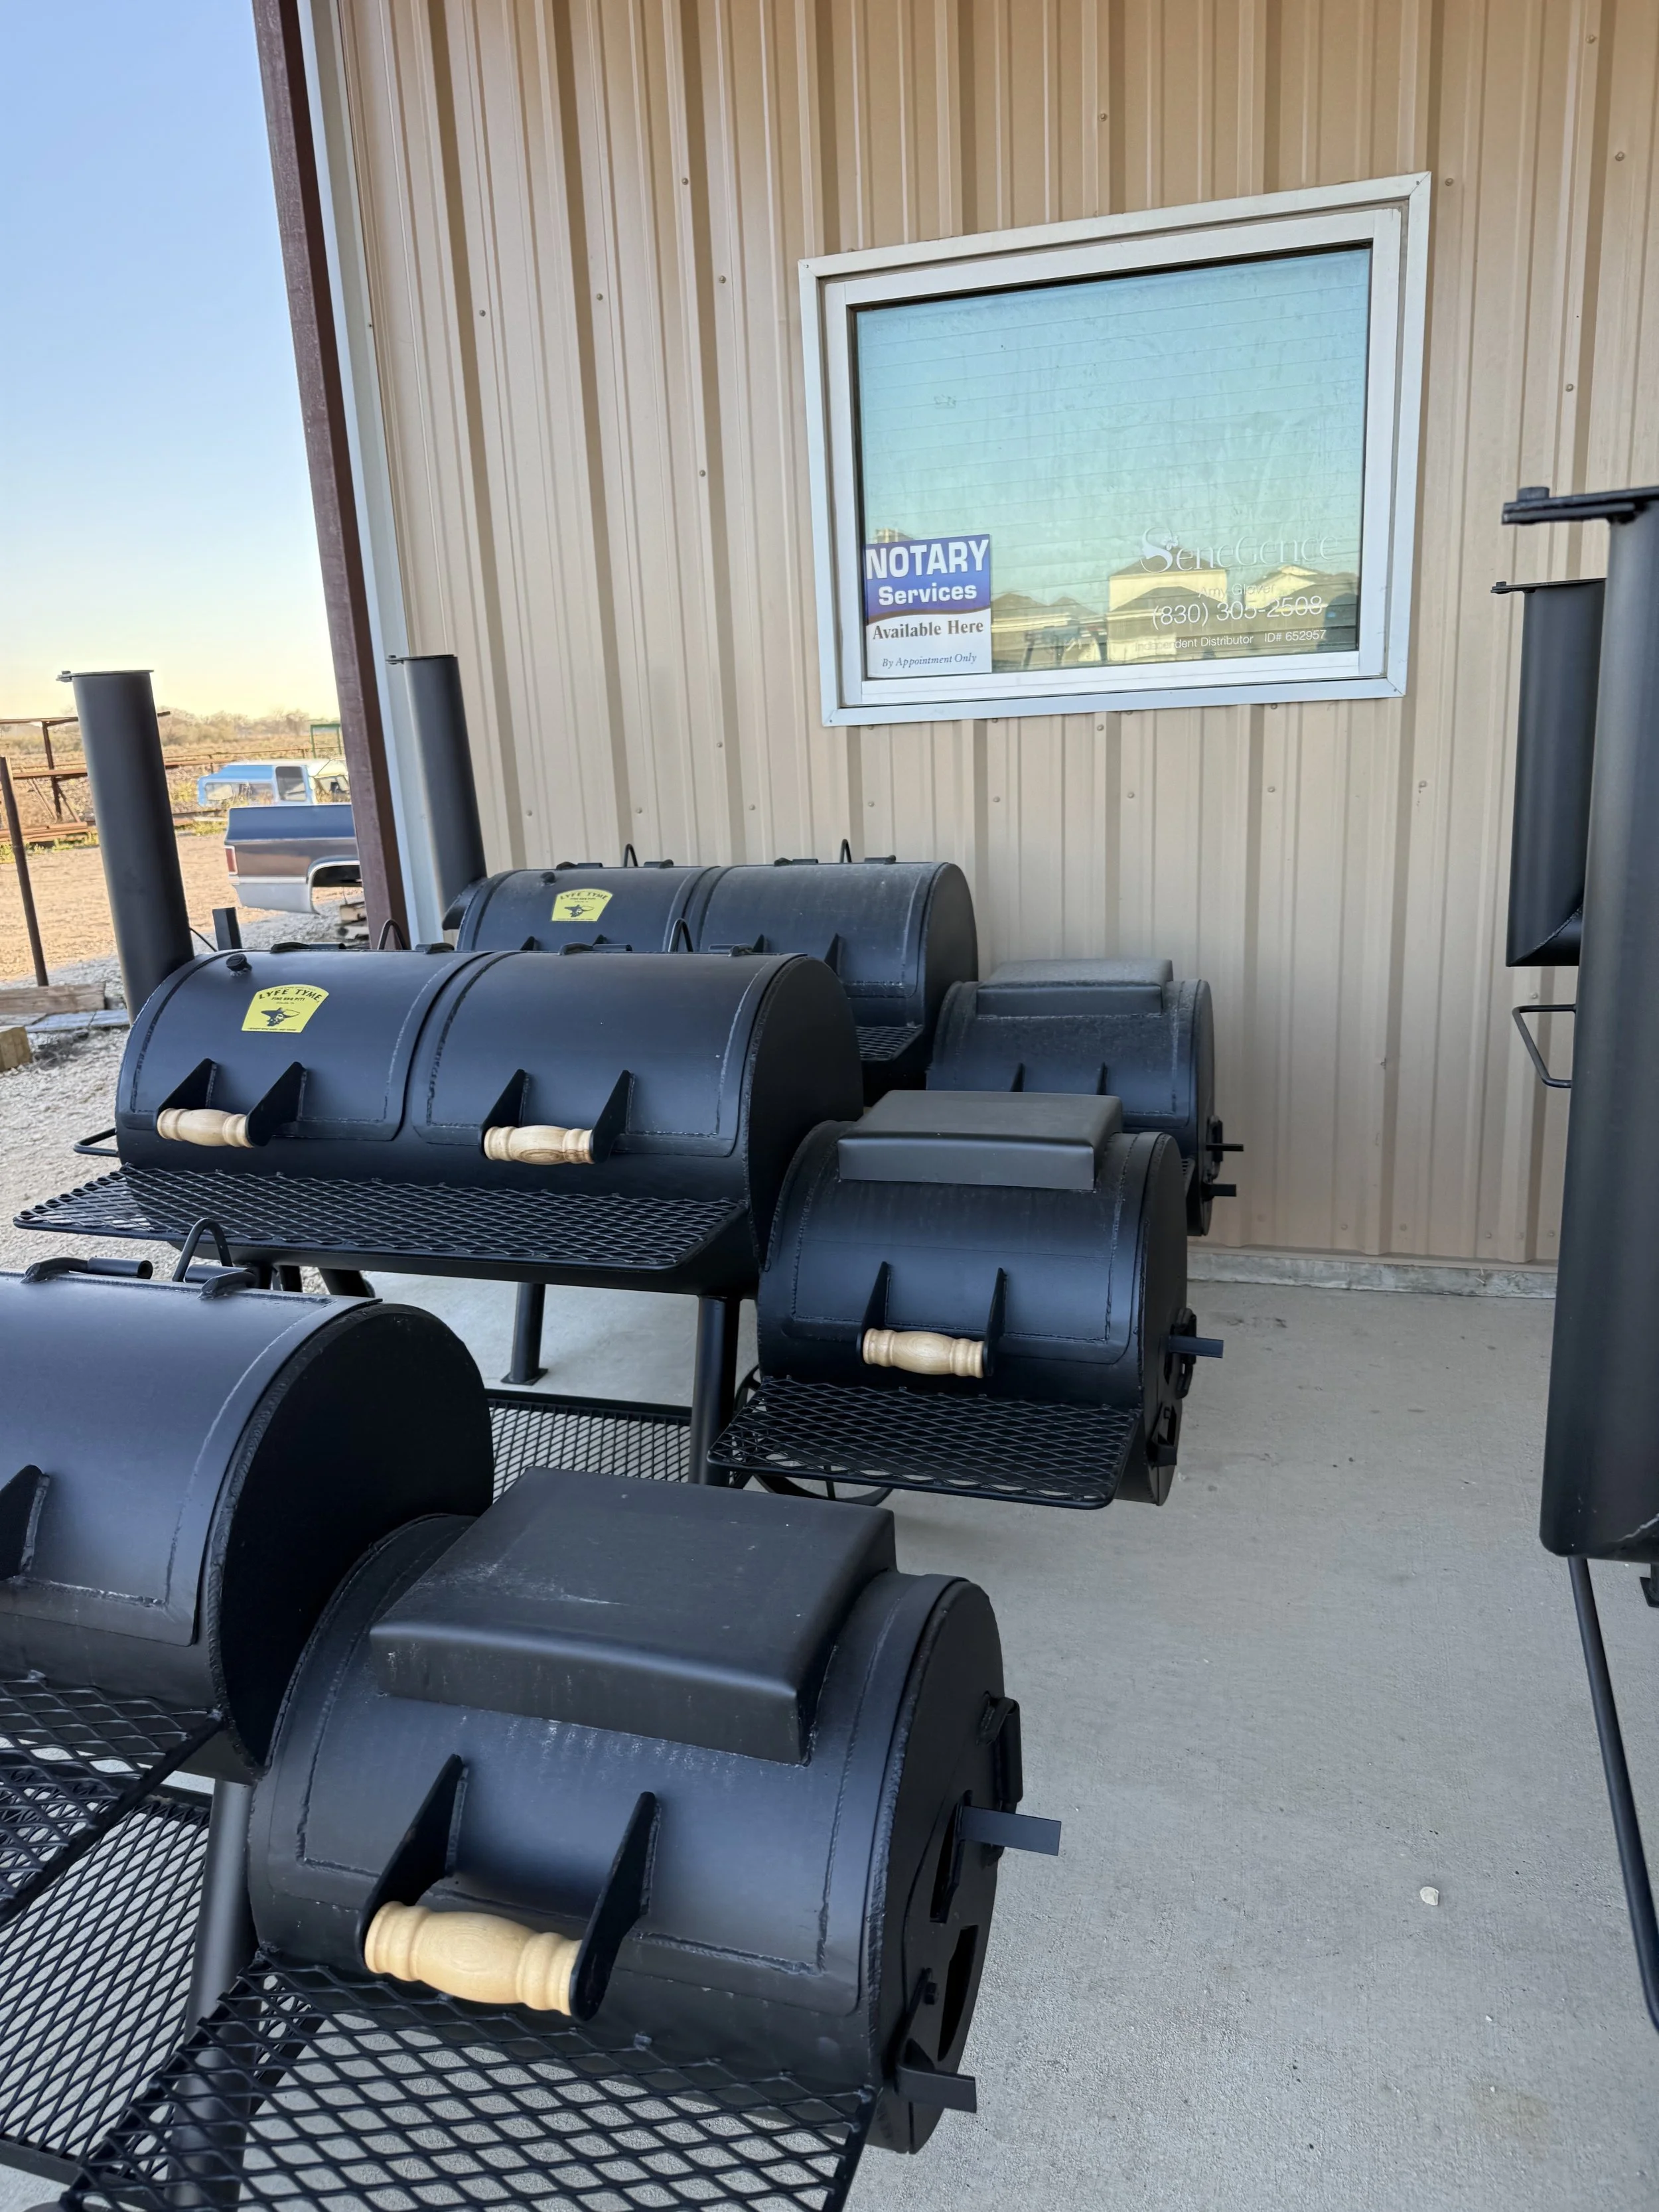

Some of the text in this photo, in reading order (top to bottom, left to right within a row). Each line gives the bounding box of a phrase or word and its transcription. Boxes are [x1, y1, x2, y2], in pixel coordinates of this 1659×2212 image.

[866, 539, 989, 579] NOTARY
[1139, 526, 1338, 574] SeneGence
[878, 583, 977, 606] Services
[1198, 583, 1275, 599] Amy Glover
[1152, 595, 1323, 630] (830) 305-2508
[873, 620, 983, 640] Available Here
[1201, 635, 1254, 647] Distributor
[1264, 632, 1283, 643] ID#
[1285, 629, 1327, 642] 652957
[882, 652, 977, 669] By Appointment Only
[259, 989, 323, 1001] LYFE TYME
